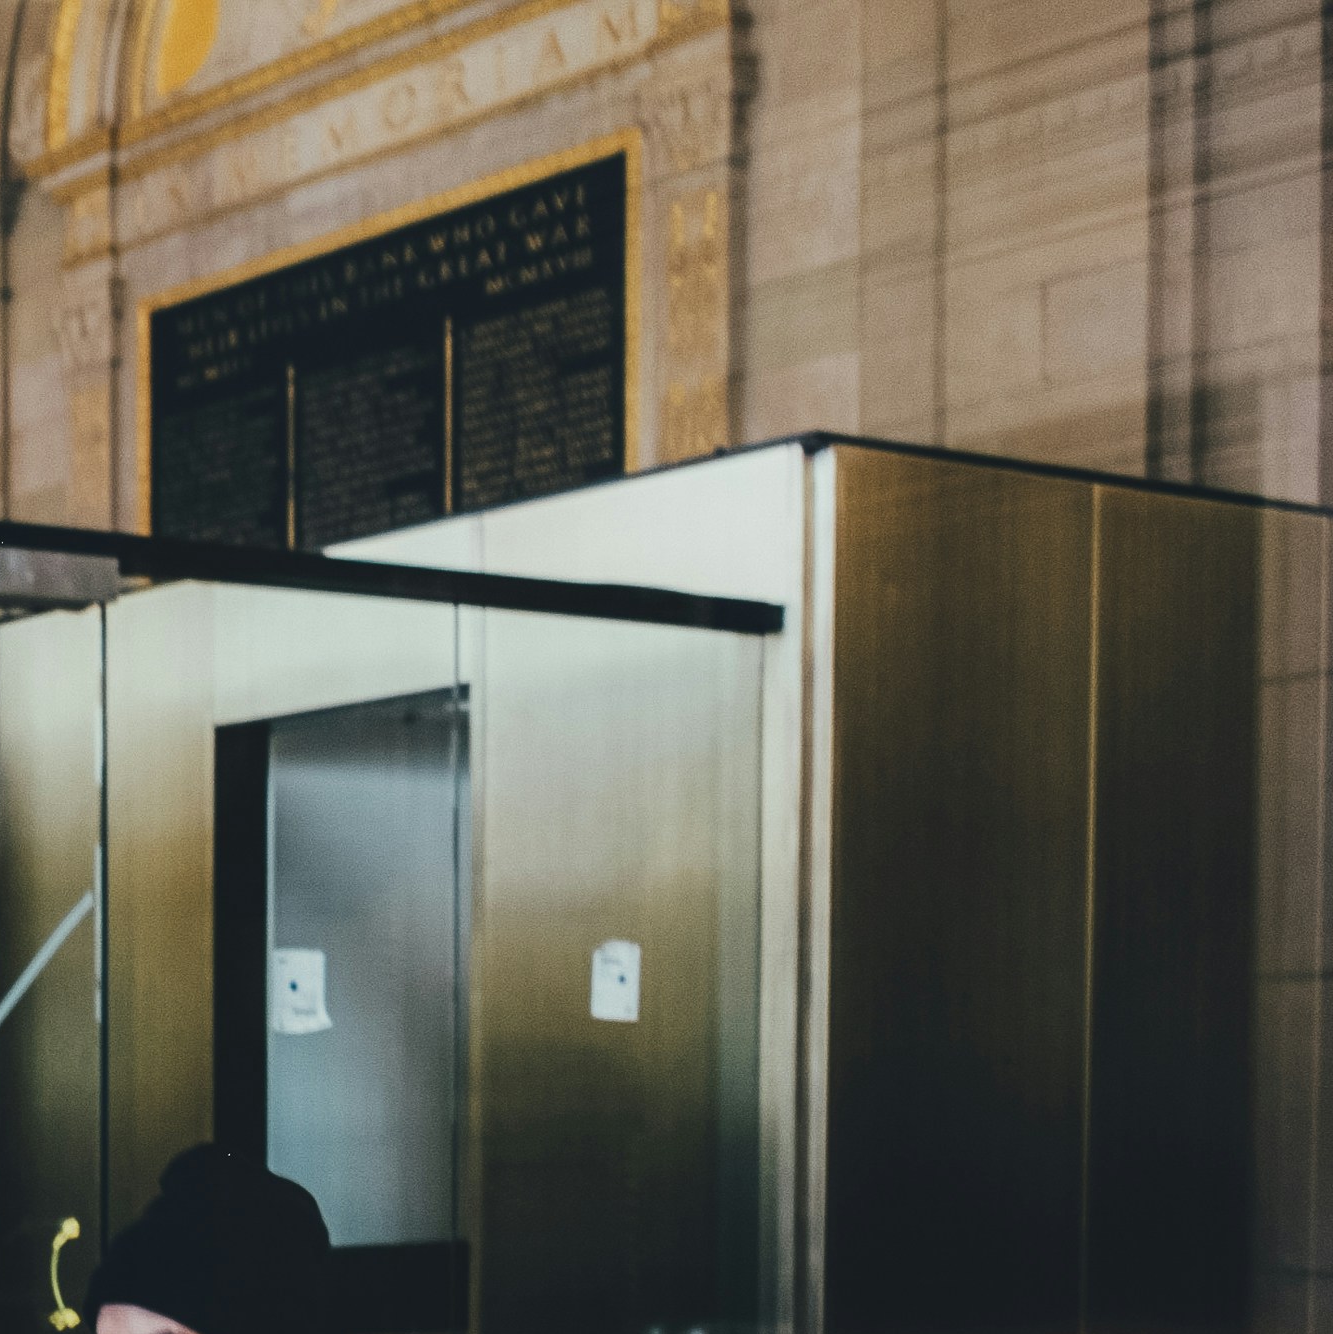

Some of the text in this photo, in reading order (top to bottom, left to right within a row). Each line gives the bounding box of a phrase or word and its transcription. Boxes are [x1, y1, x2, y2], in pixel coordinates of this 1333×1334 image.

[318, 295, 348, 323] IN
[417, 241, 506, 289] GREAT
[526, 212, 591, 252] WAR
[344, 242, 418, 286] BANK
[429, 213, 496, 253] WHO
[509, 183, 587, 228] GAVE
